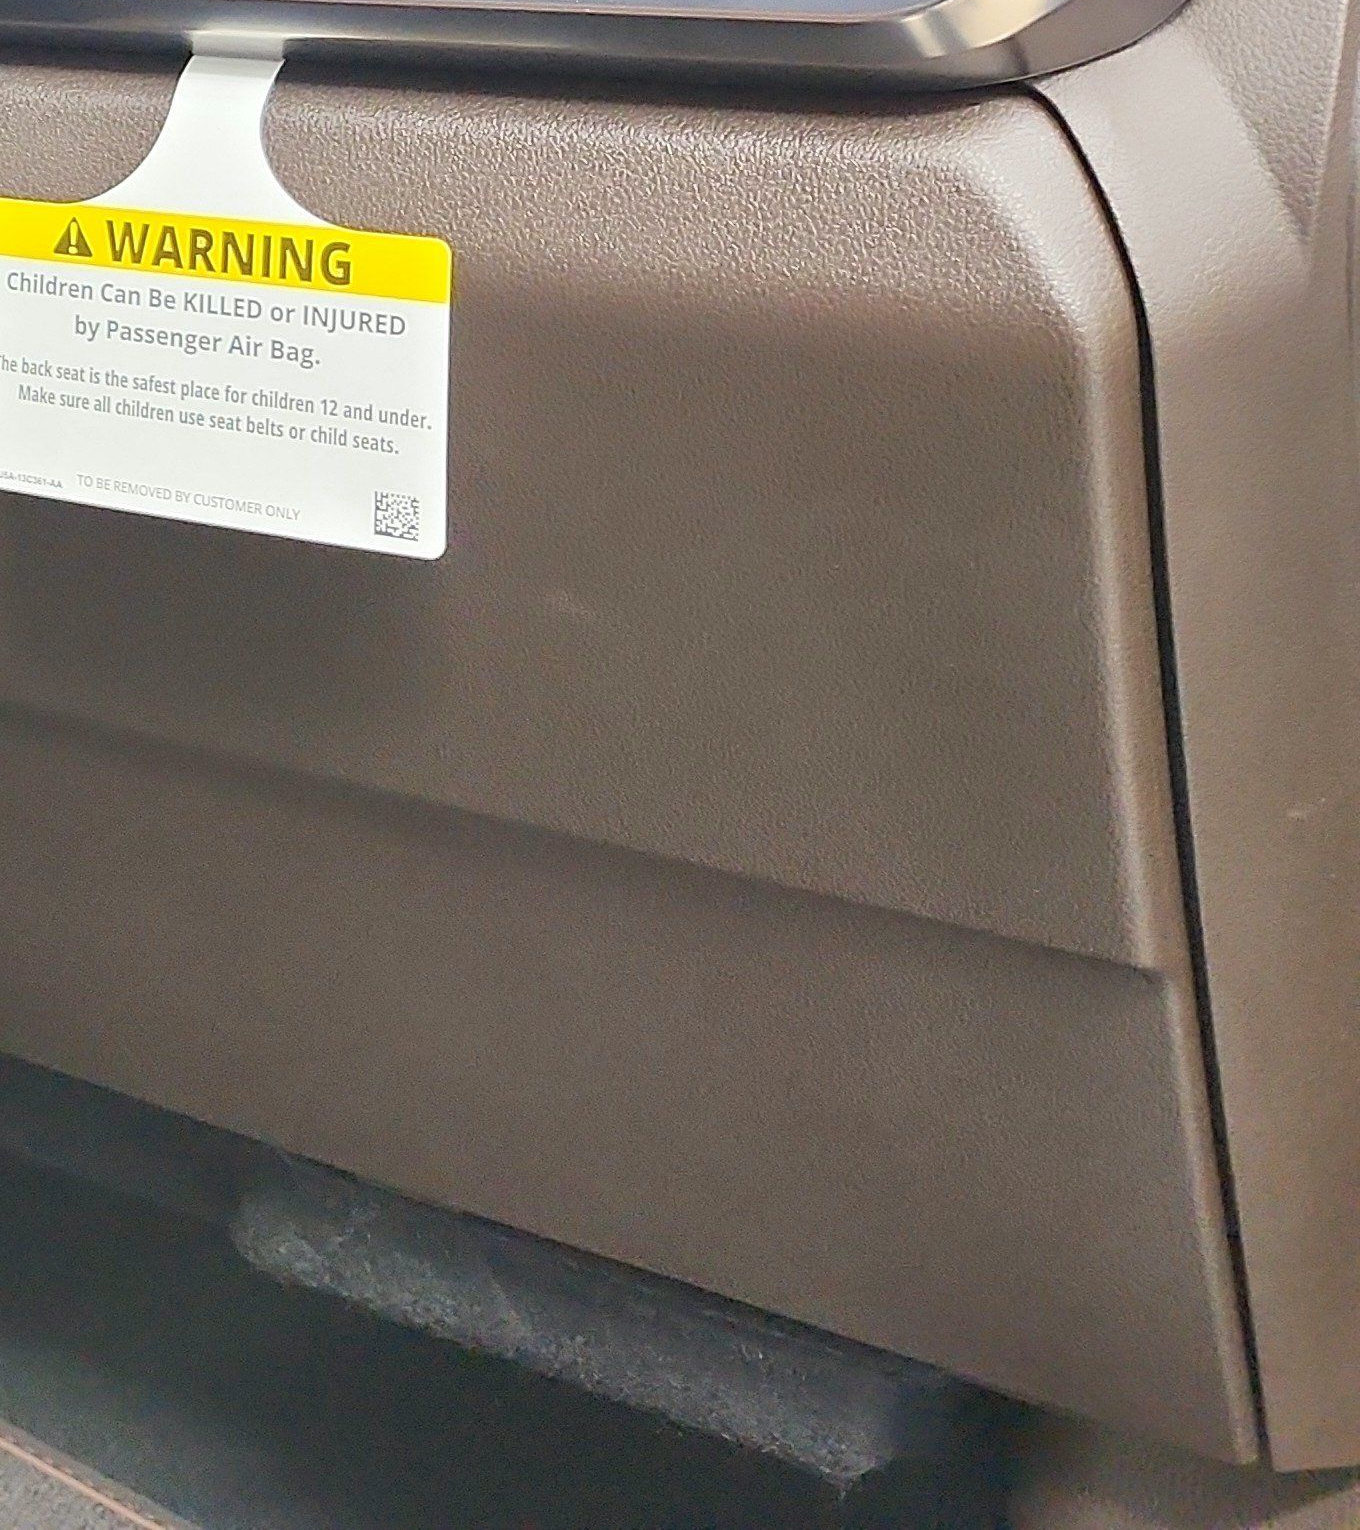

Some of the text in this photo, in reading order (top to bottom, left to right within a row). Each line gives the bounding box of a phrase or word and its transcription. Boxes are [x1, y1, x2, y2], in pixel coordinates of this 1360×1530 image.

[105, 219, 352, 286] WARNING
[6, 272, 406, 336] Children Can Be KILLED or INJURED
[74, 315, 321, 368] by Passenger Air Bag.
[18, 384, 399, 455] Make sure all children use seat belts or child seats.
[21, 357, 53, 378] back
[55, 365, 85, 383] seat
[89, 367, 101, 385] is
[105, 369, 128, 389] the
[132, 375, 176, 395] safest
[180, 379, 221, 403] place
[224, 385, 247, 404] for
[251, 389, 314, 414] children
[320, 399, 338, 417] 12
[343, 404, 373, 421] and
[378, 409, 433, 430] under.
[76, 473, 301, 521] TO BE REMOVED BY CUSTOMER ONLY
